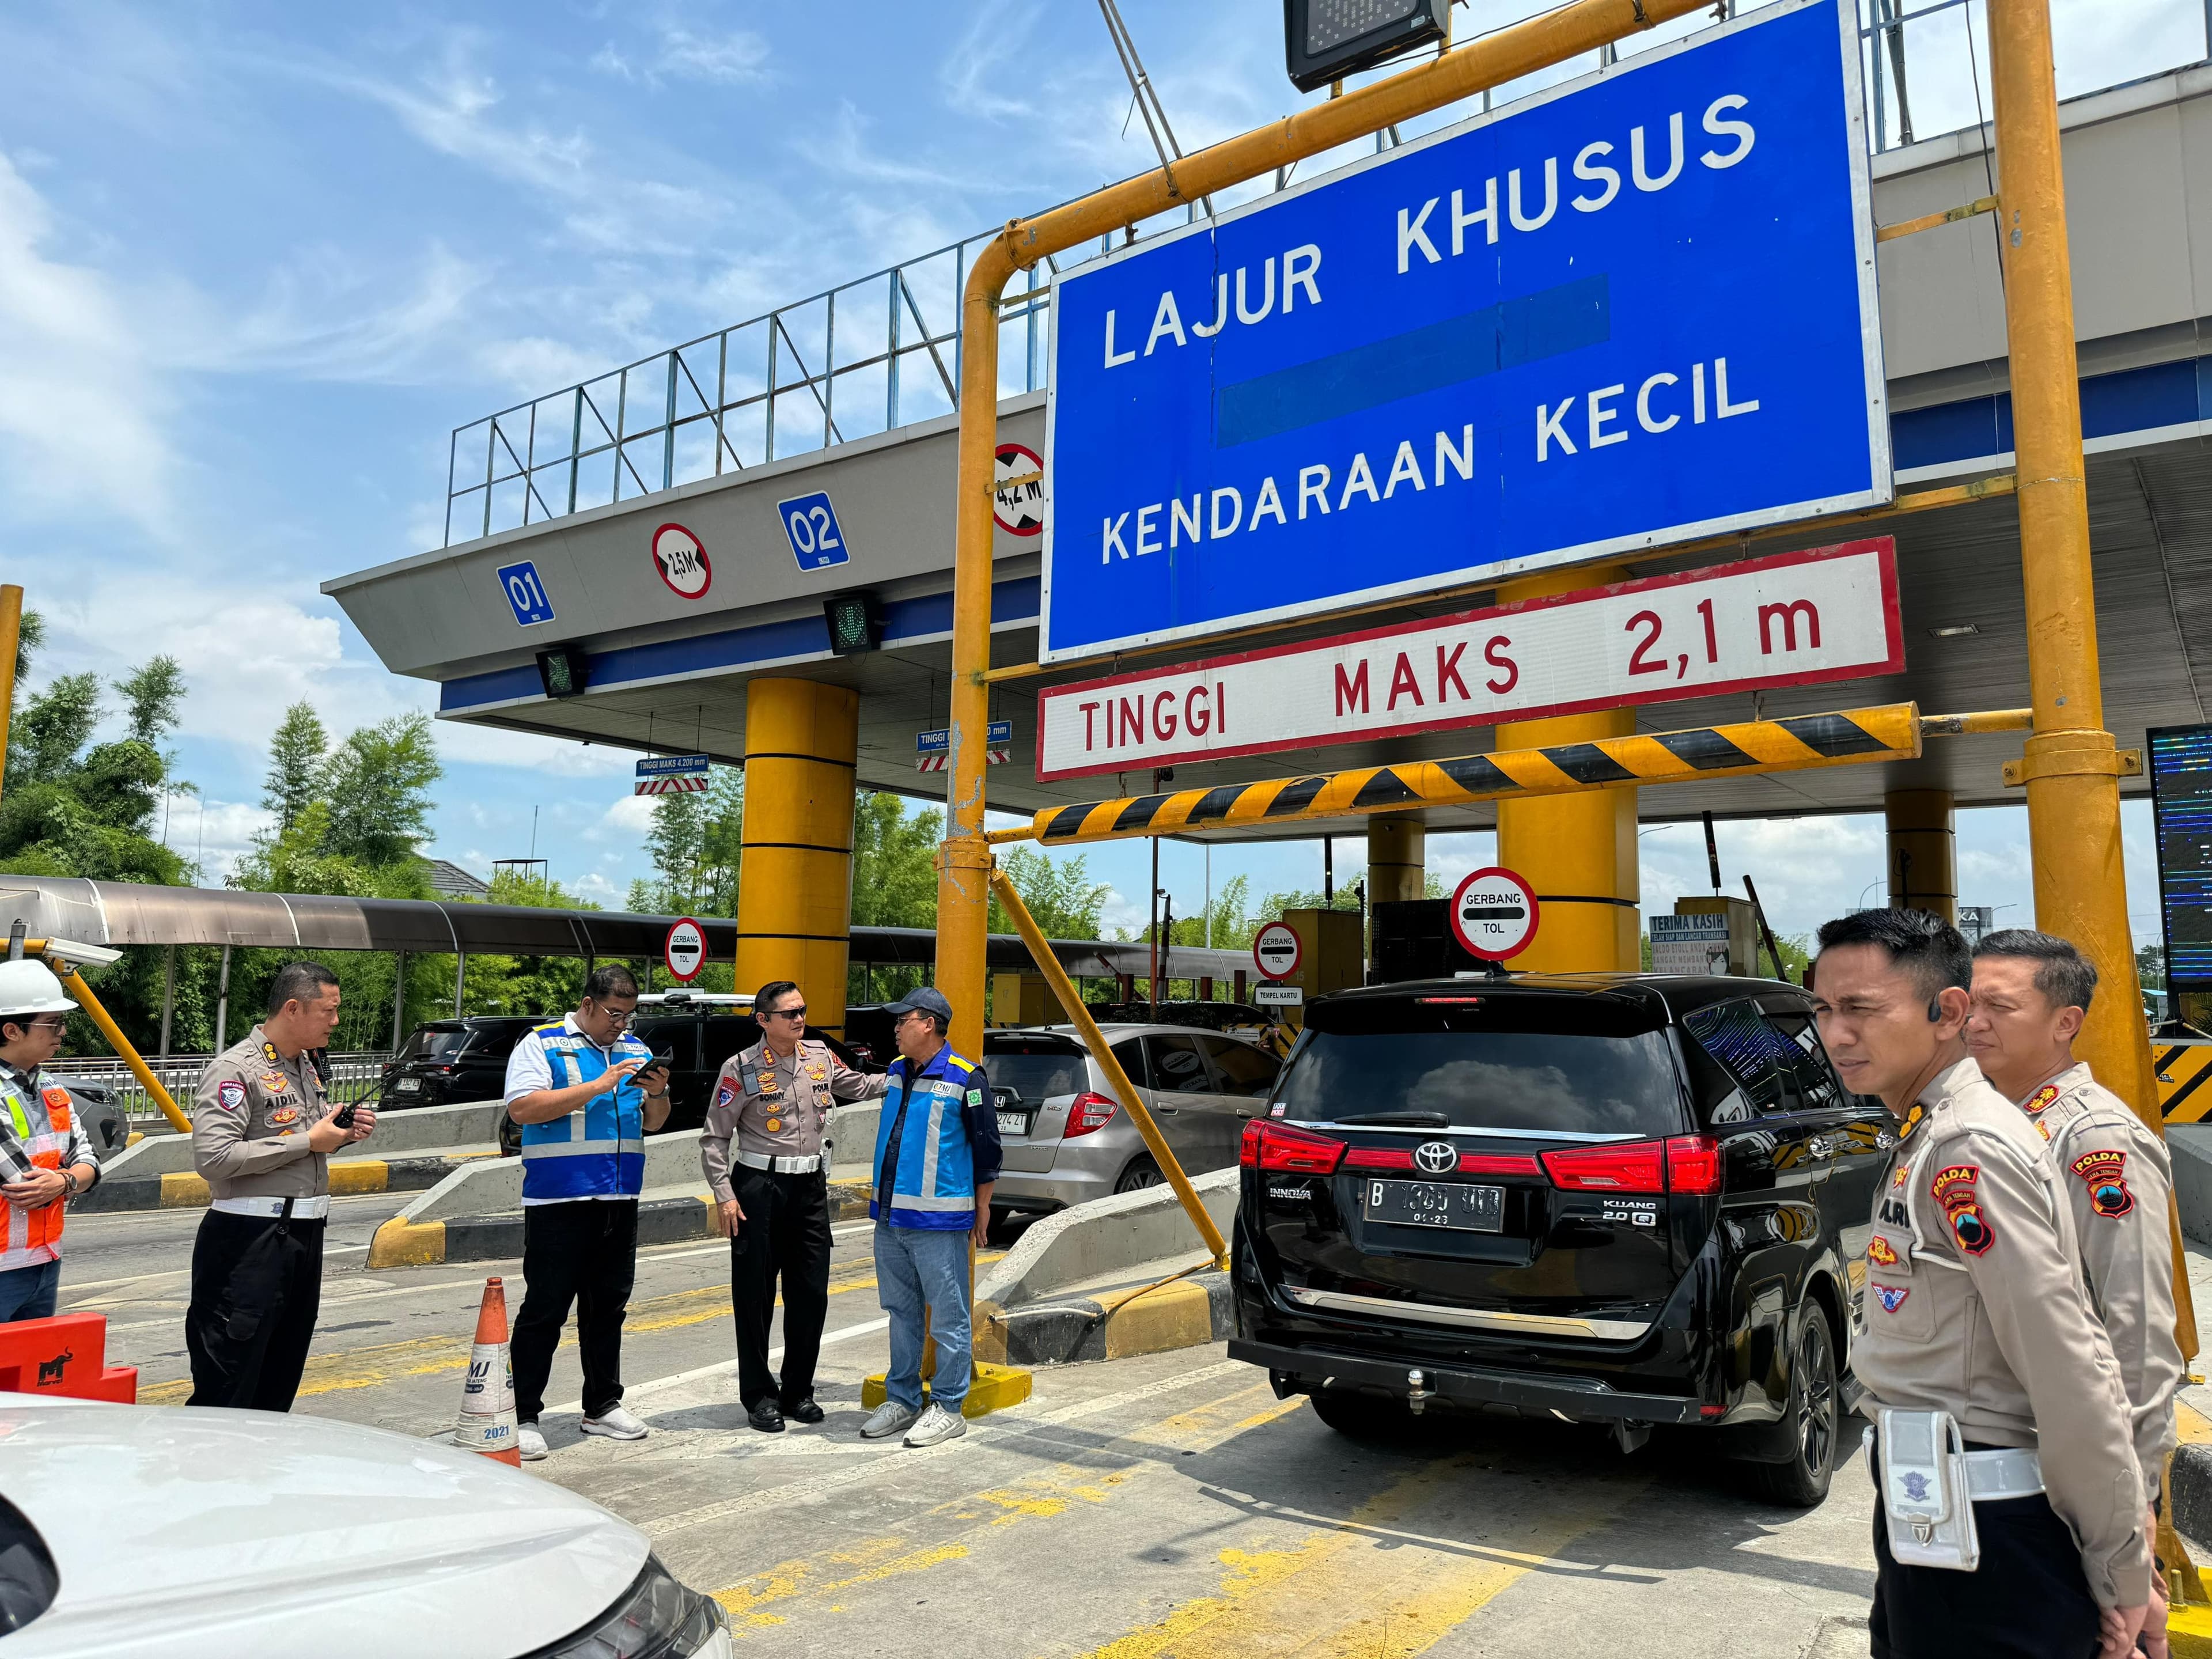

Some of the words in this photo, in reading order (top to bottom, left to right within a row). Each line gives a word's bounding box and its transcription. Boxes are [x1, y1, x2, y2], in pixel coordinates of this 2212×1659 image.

[1104, 244, 1321, 369] LAJUR
[1397, 94, 1755, 274] KHUSUS
[1102, 424, 1475, 565] KENDARAAN
[1537, 357, 1759, 462] KECIL
[790, 506, 839, 554] 02
[509, 571, 544, 611] 01
[1080, 683, 1226, 751] TINGGI
[1335, 635, 1518, 717] MAKS
[1626, 599, 1718, 679] 2,1
[1759, 599, 1821, 654] m
[921, 733, 945, 744] TINGGI
[993, 726, 1006, 734] mm
[639, 761, 658, 770] TINGGI
[659, 759, 676, 768] MAKS
[677, 758, 693, 767] 4.200
[1466, 893, 1521, 904] GERBANG
[1483, 923, 1505, 933] TOL
[1652, 915, 1690, 931] TERIMA
[1692, 914, 1724, 930] KASIH
[265, 1093, 298, 1108] AIDIL
[2075, 1153, 2120, 1172] POLDA
[1933, 1168, 1971, 1196] POLDA
[1270, 1187, 1312, 1200] INNOVA
[1372, 1183, 1383, 1206] B
[1603, 1211, 1628, 1221] 2.0
[484, 1425, 509, 1440] 2021
